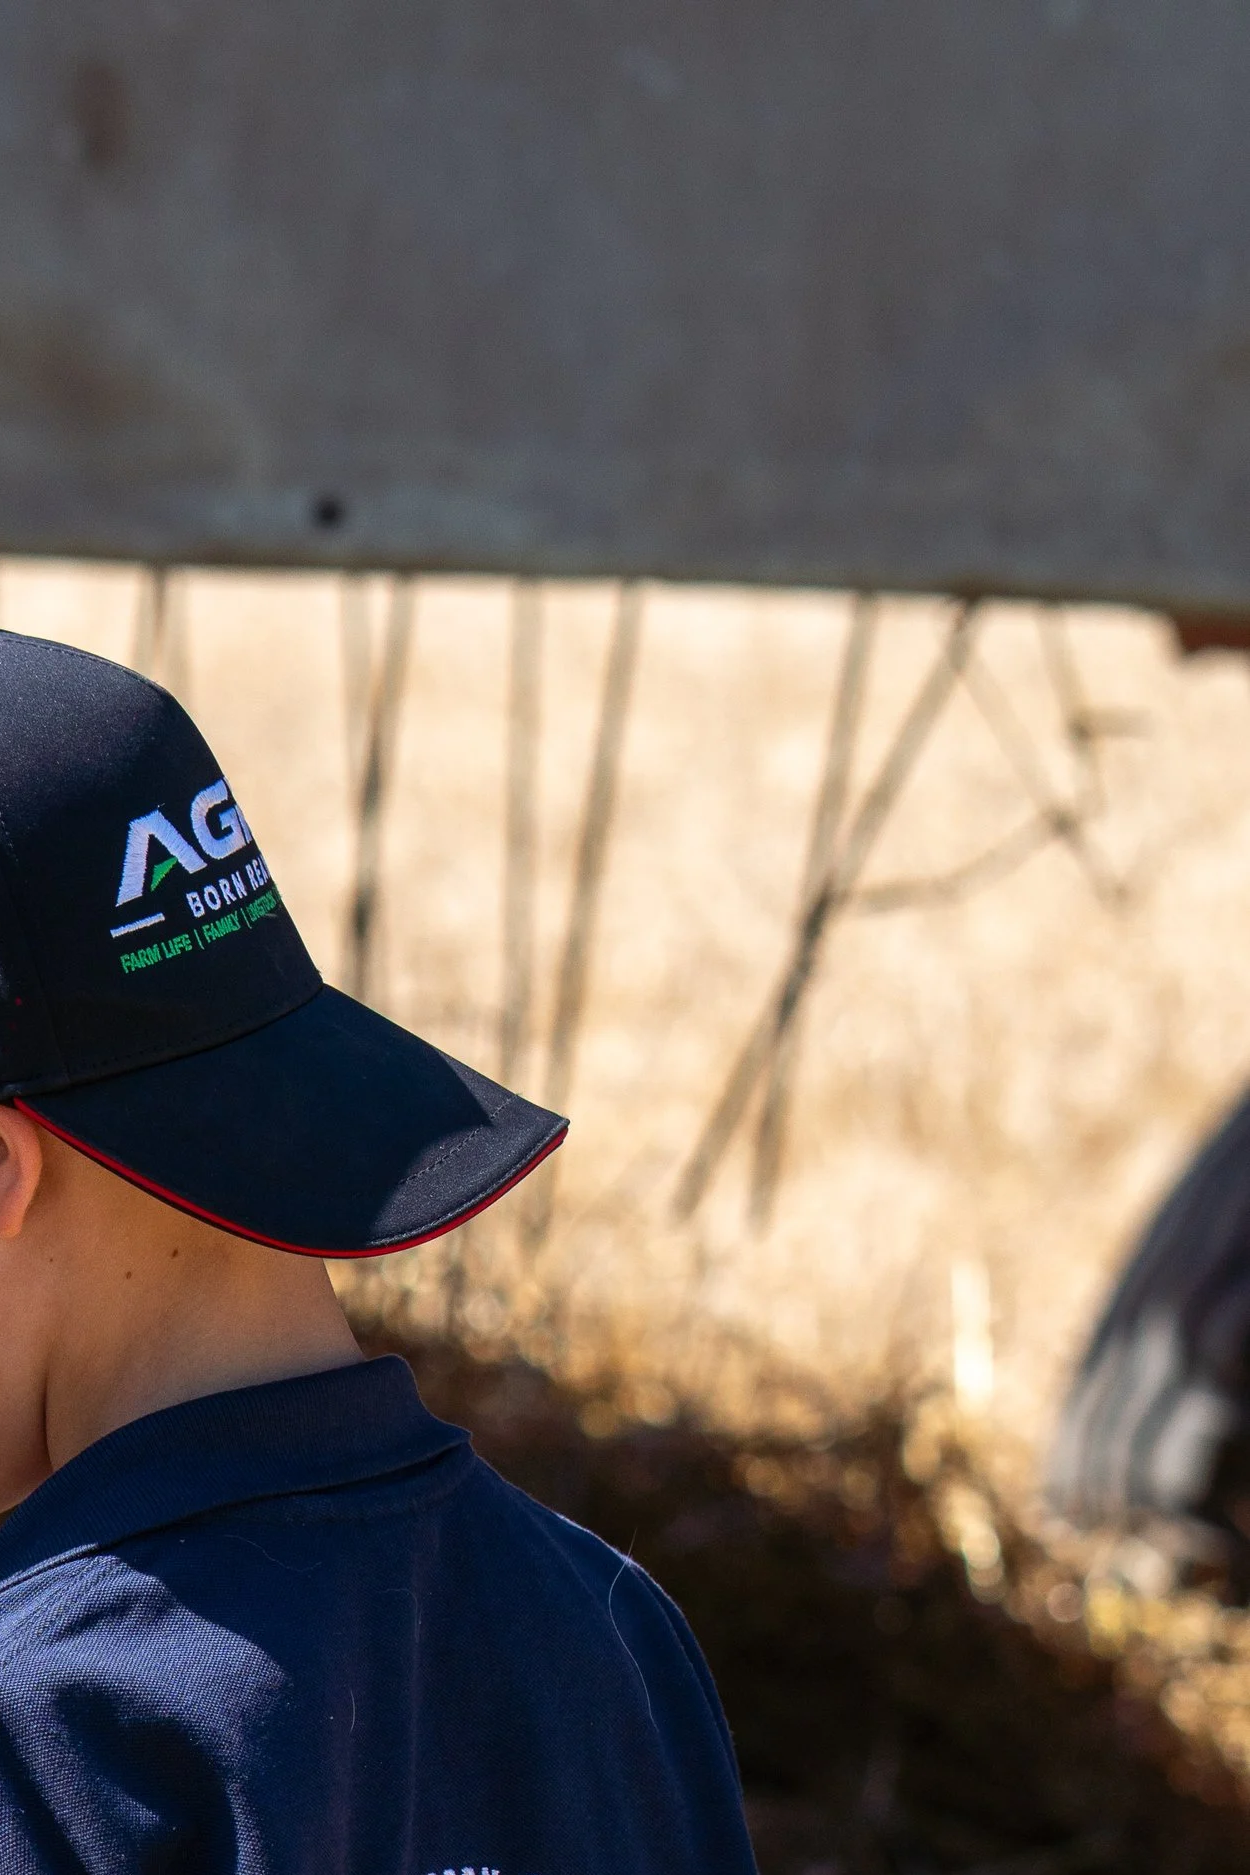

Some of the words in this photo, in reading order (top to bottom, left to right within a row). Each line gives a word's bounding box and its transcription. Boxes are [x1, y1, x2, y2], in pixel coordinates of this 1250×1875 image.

[115, 776, 252, 907] AG
[186, 871, 247, 918] BORN
[120, 942, 161, 974] FARM
[161, 934, 193, 959] LIFE
[202, 911, 242, 943] FAMILY
